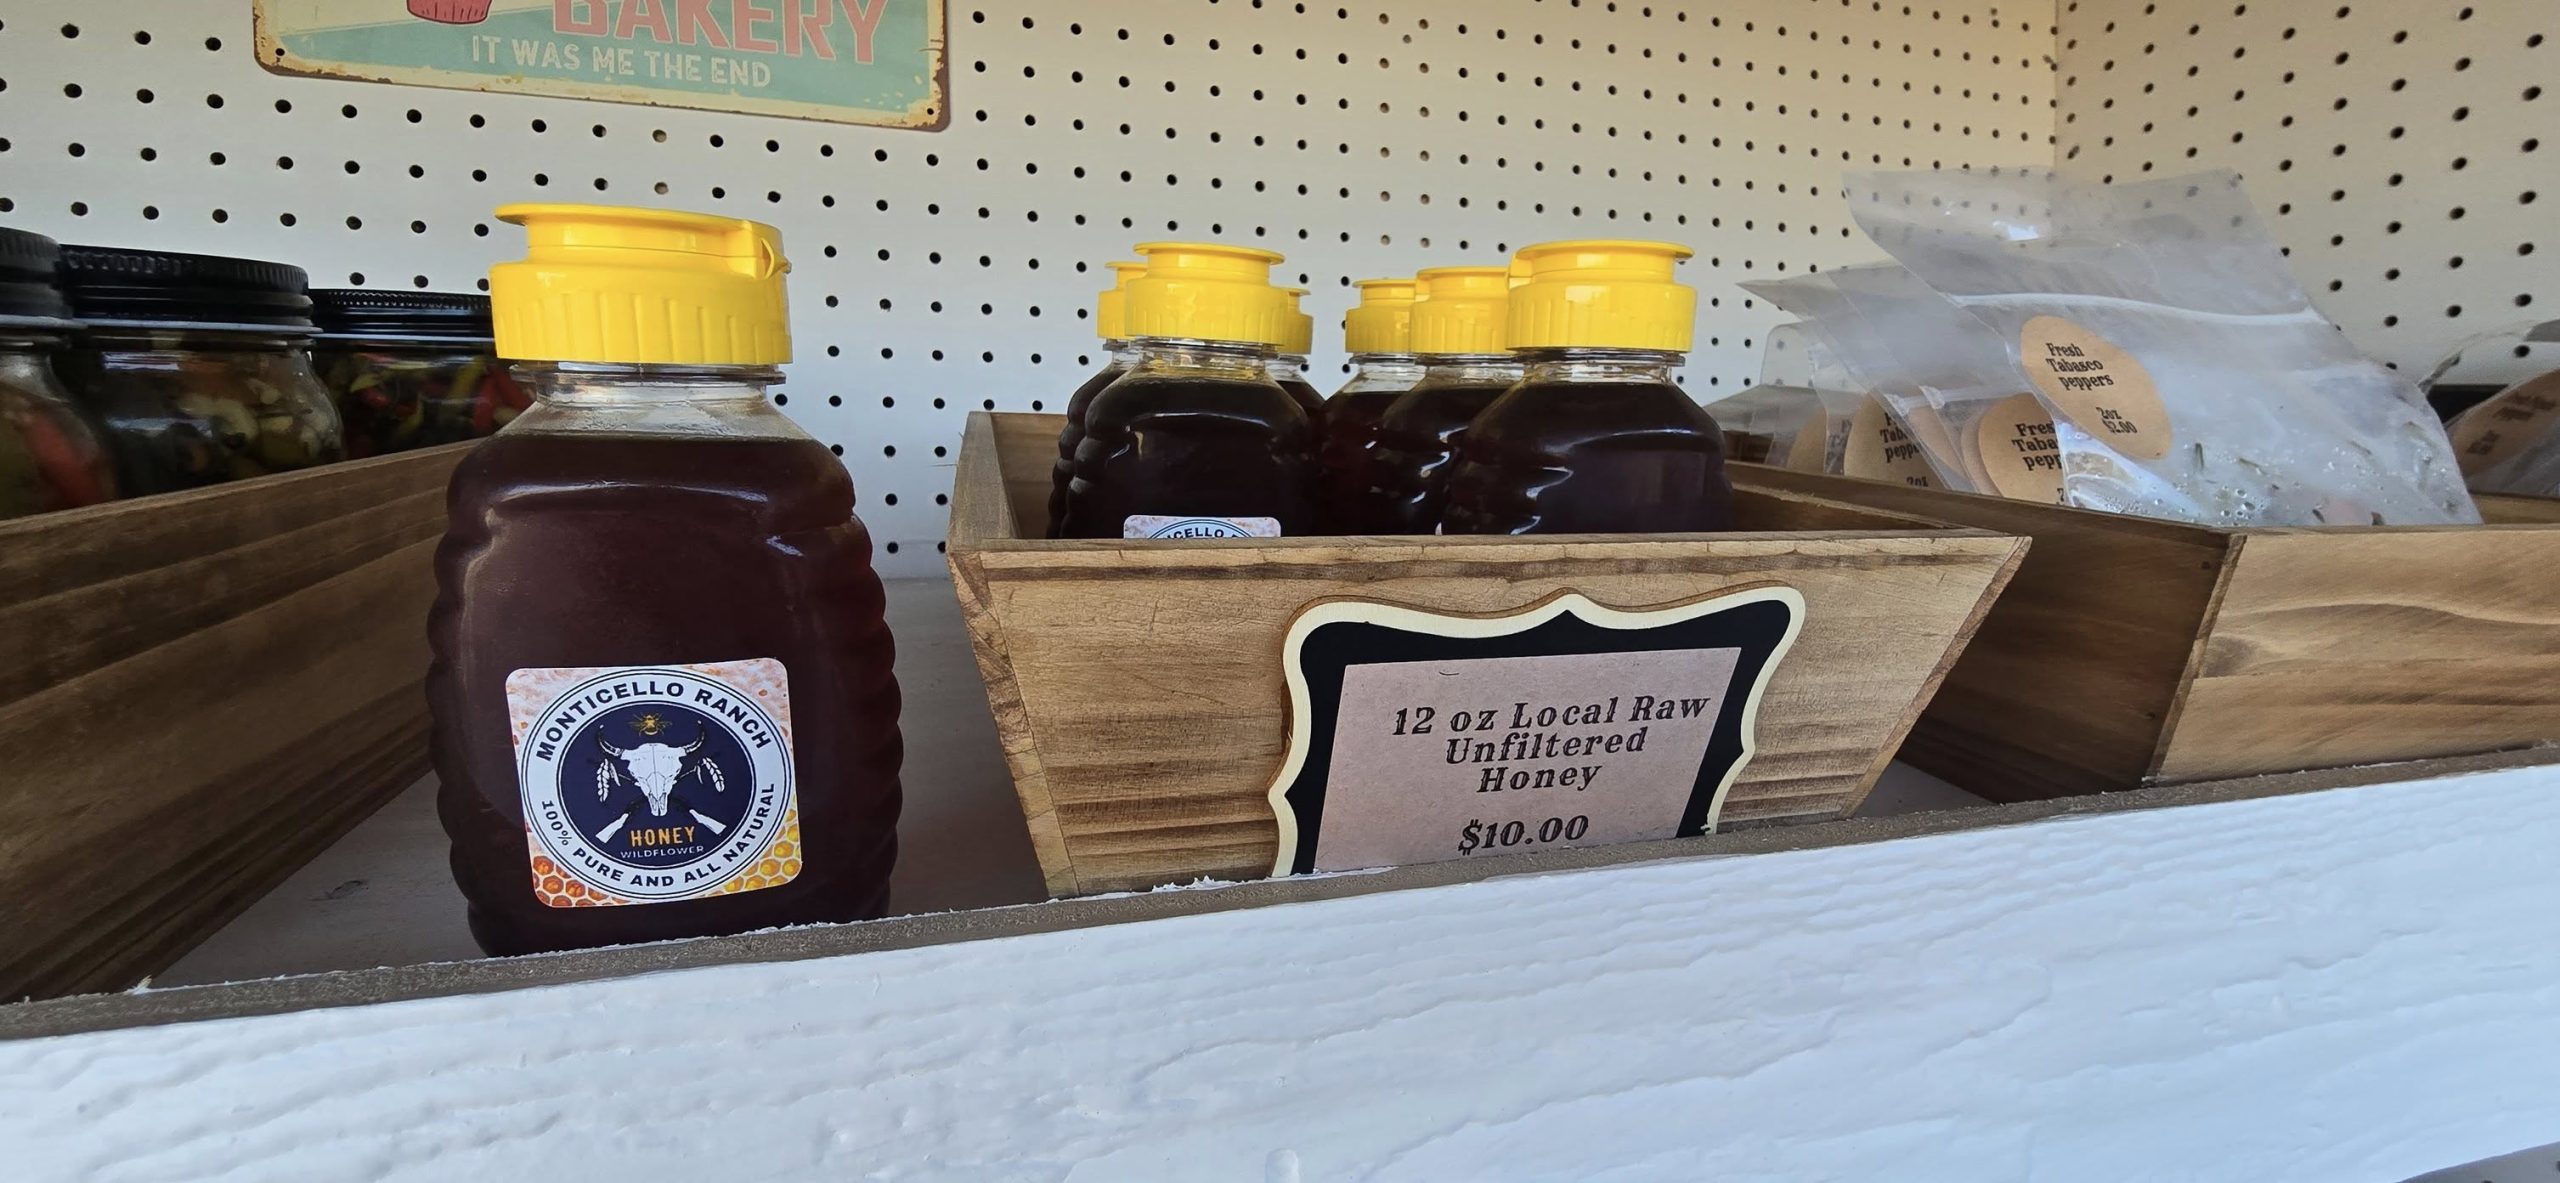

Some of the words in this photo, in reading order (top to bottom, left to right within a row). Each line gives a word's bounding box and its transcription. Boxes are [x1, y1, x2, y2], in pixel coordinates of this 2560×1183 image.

[472, 35, 501, 63] IT
[511, 39, 580, 70] WAS
[593, 46, 634, 75] ME
[644, 50, 702, 81] THE
[711, 57, 770, 87] END
[2046, 342, 2085, 357] Fresh
[2045, 358, 2104, 372] Tabasco
[2058, 374, 2114, 391] peppers
[2096, 406, 2122, 420] 2oz
[2015, 421, 2056, 437] Fres
[2101, 419, 2138, 433] $2.00
[536, 681, 684, 761] MONTICELLO
[694, 688, 771, 750] RANCH
[1392, 707, 1436, 736] 12
[1450, 708, 1498, 734] oz
[1509, 697, 1617, 730] Local
[1627, 695, 1711, 722] Raw
[1446, 727, 1649, 764] Unfiltered
[1476, 764, 1602, 794] Honey
[541, 800, 573, 846] 100%
[573, 847, 624, 882] PURE
[630, 874, 674, 887] AND
[684, 863, 721, 883] ALL
[726, 784, 775, 863] NATURAL
[630, 826, 695, 847] HONEY
[1458, 815, 1589, 856] $10.00
[620, 845, 704, 858] WILDFLOWER
